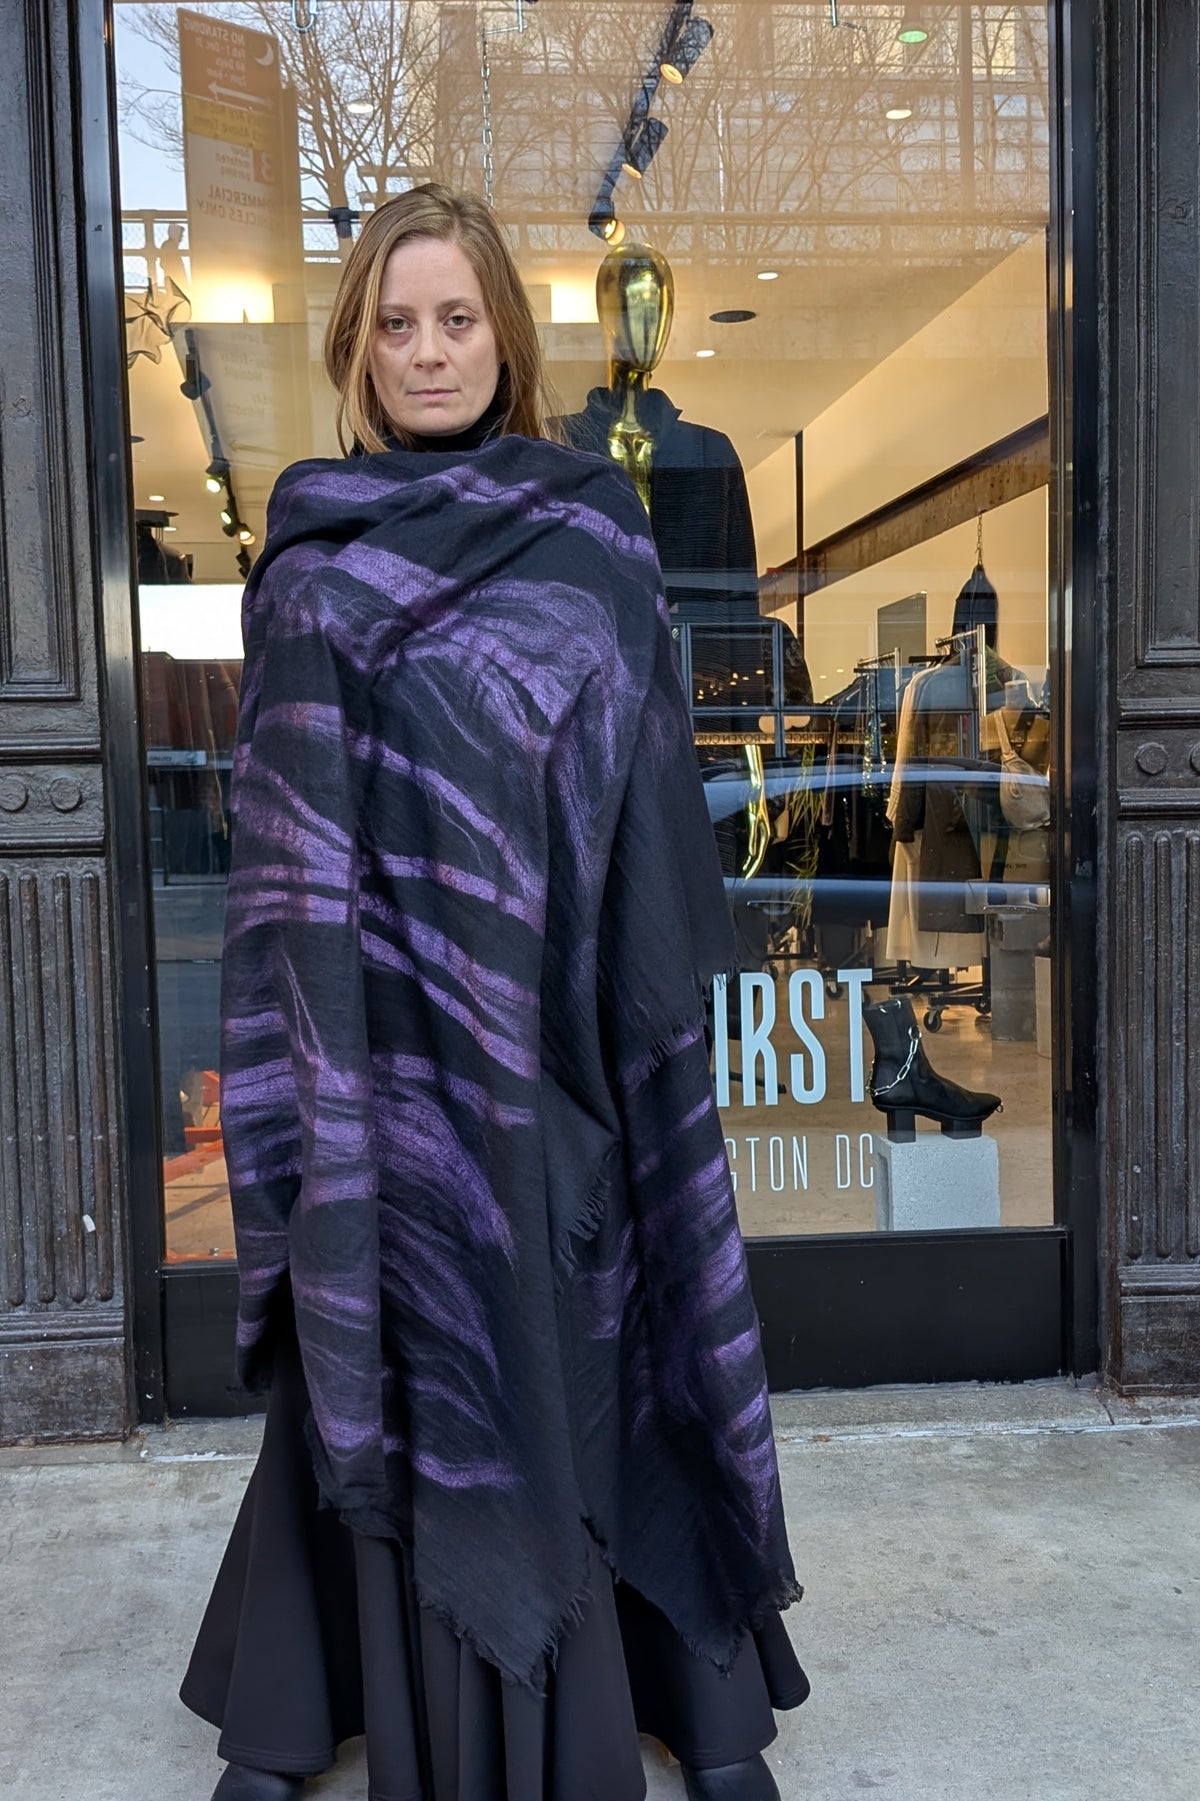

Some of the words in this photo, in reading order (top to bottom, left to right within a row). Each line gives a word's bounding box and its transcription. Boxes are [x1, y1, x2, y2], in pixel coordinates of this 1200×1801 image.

[713, 968, 873, 1107] IRST
[724, 1135, 808, 1192] GTON
[836, 1133, 874, 1189] DC
